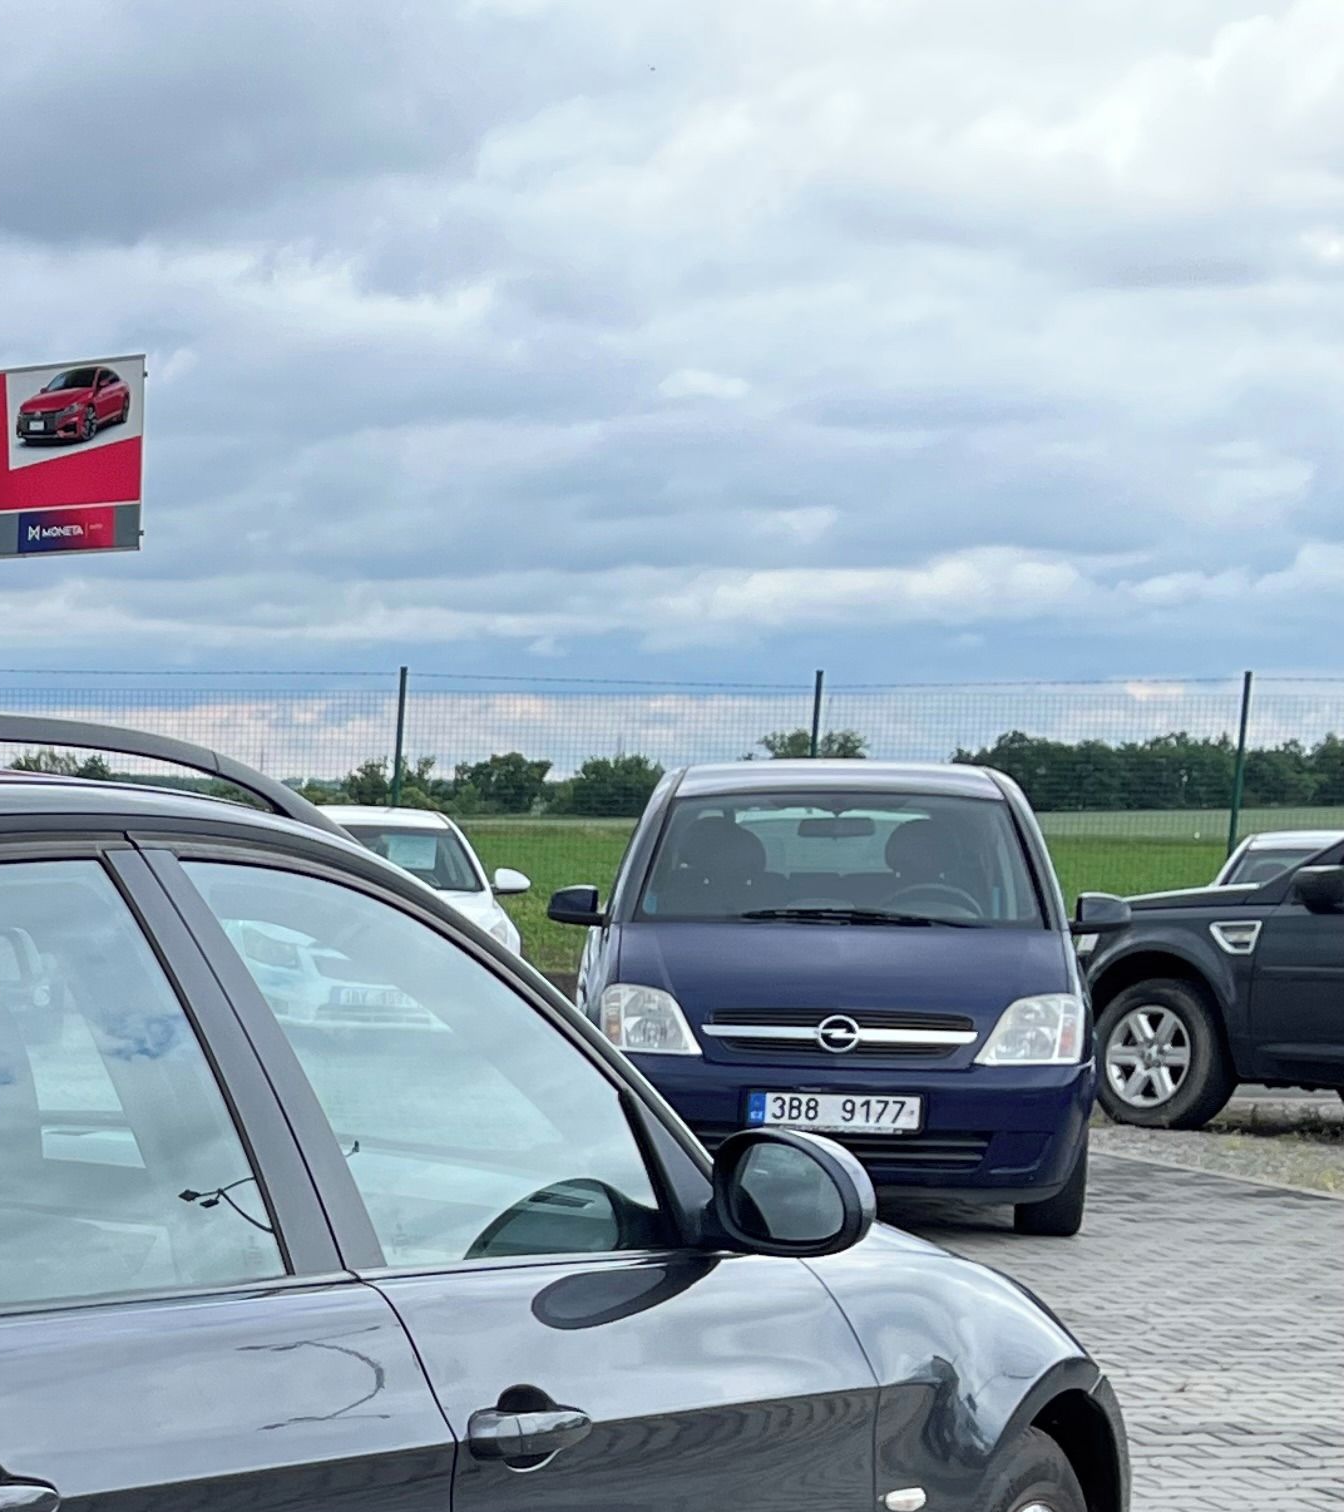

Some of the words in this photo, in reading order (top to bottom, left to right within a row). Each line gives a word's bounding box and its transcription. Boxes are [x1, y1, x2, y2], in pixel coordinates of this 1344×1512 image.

[41, 525, 84, 537] MONETA
[771, 1096, 819, 1121] 3B8
[841, 1099, 906, 1124] 9177
